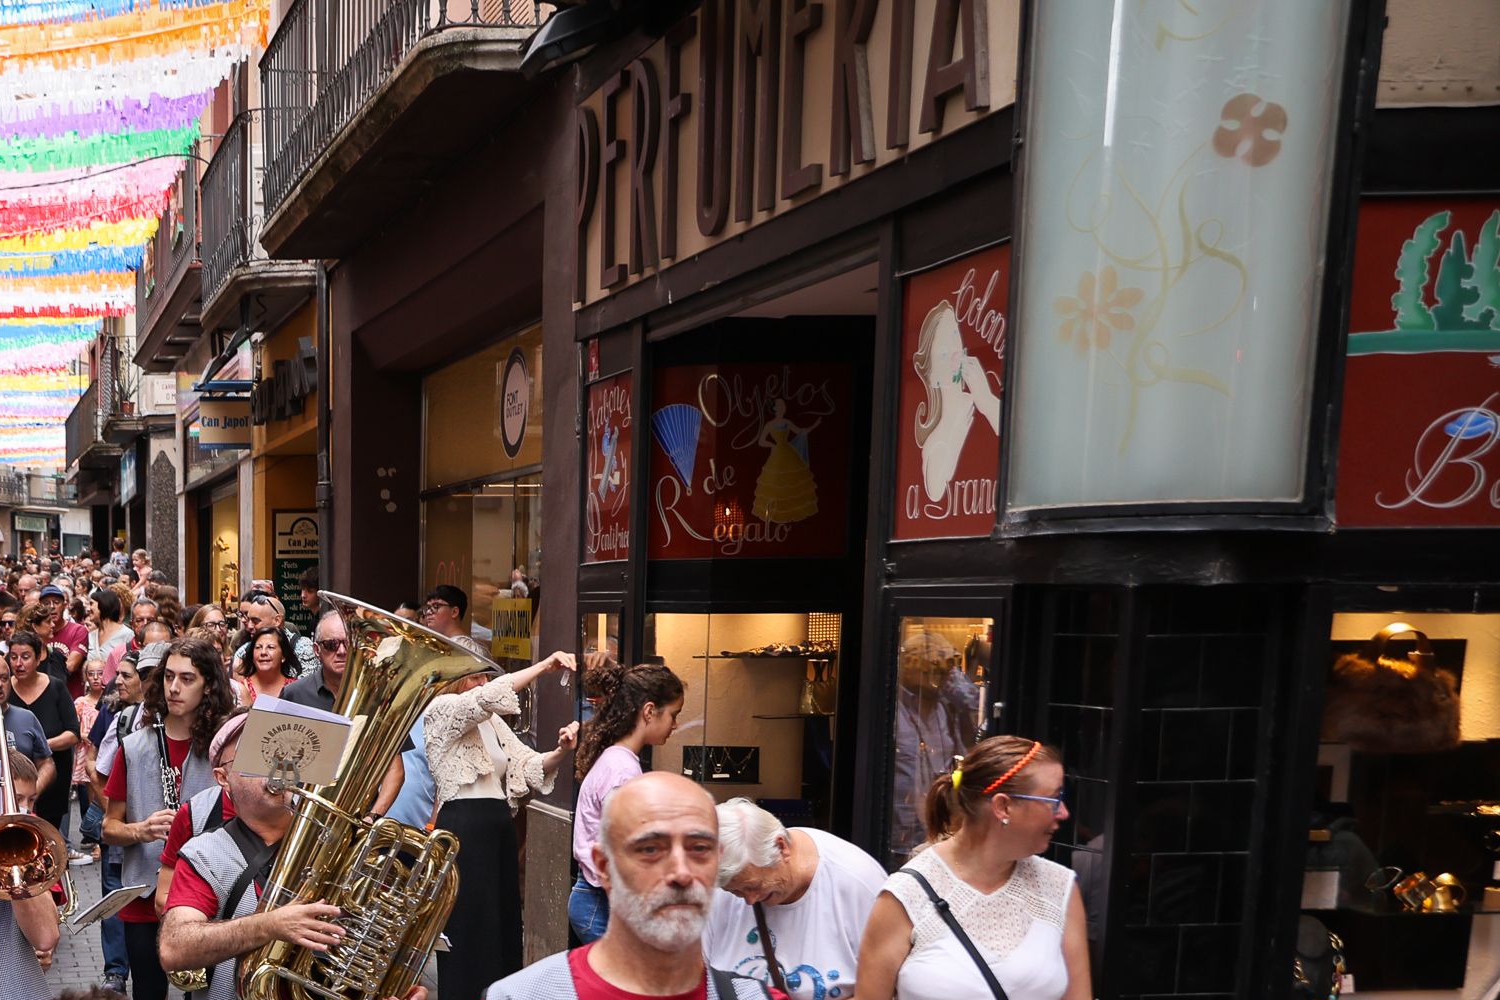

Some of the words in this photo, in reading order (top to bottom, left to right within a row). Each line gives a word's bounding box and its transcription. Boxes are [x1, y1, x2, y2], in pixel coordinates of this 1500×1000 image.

[506, 391, 519, 407] FONT
[506, 403, 523, 418] OUTLET
[698, 366, 835, 449] Objetos
[201, 415, 220, 428] Can
[703, 458, 736, 496] de
[655, 475, 791, 555] Regalo
[906, 484, 920, 519] a
[260, 736, 270, 744] LA
[268, 723, 291, 737] BANDA
[293, 723, 305, 732] DEL
[305, 729, 321, 752] VERMUT
